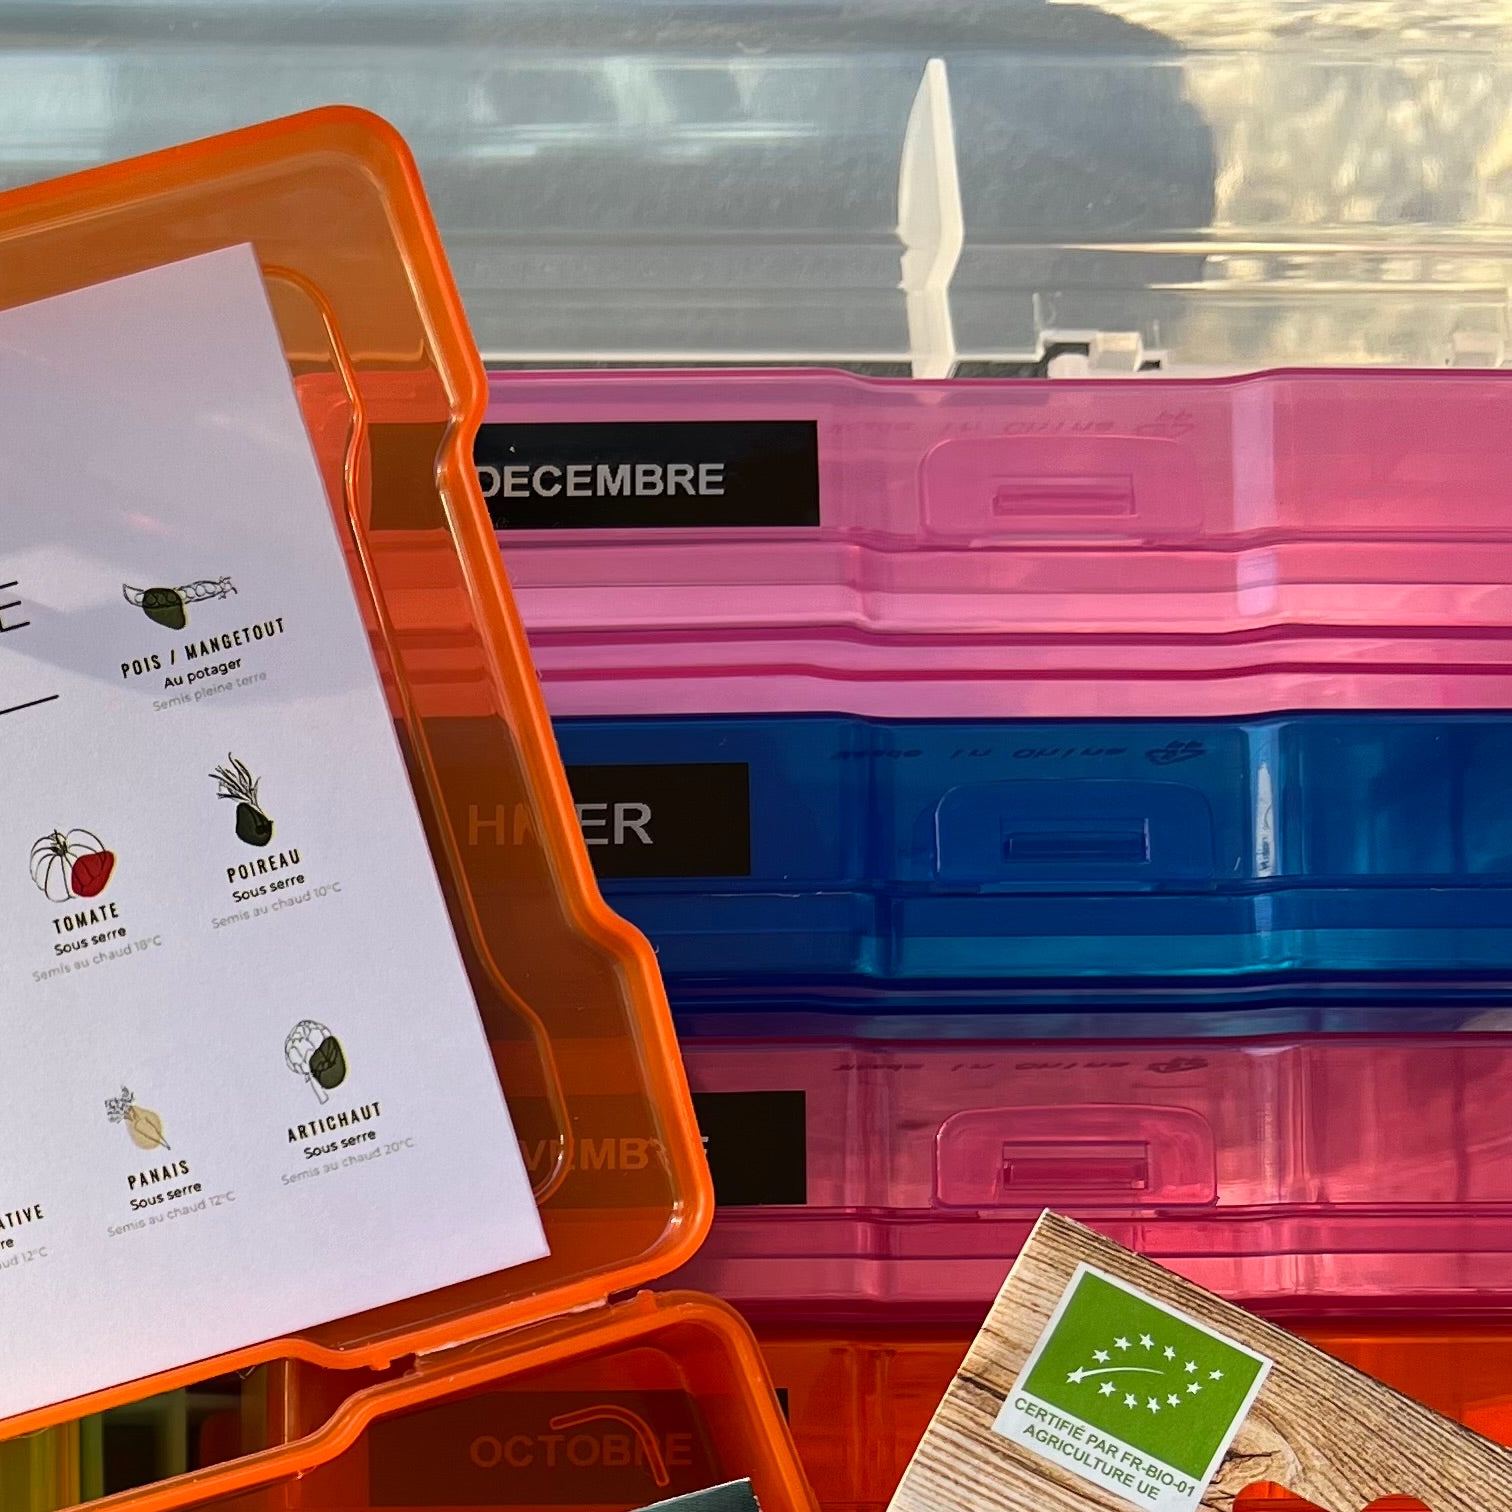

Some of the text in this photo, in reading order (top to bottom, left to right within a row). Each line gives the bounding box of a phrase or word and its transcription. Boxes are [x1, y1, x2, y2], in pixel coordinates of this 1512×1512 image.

[476, 463, 726, 498] DECEMBRE
[119, 616, 284, 679] POIS / MANGETOUT
[151, 671, 267, 712] Semis pleine terre
[163, 657, 241, 689] Au potager
[225, 847, 300, 884] POIREAU
[231, 873, 305, 903] Sous serre
[51, 901, 119, 935] TOMATE
[210, 909, 251, 930] Semis
[252, 905, 269, 917] au
[270, 889, 312, 912] chaud
[53, 926, 127, 956] Sous serre
[31, 961, 71, 983] Semis
[72, 958, 90, 970] au
[91, 942, 133, 965] chaud
[286, 1100, 380, 1143] ARTICHAUT
[302, 1129, 376, 1160] Sous serre
[126, 1158, 190, 1191] PANAIS
[280, 1166, 321, 1186] Semis
[322, 1160, 339, 1174] au
[340, 1145, 382, 1168] chaud
[128, 1181, 202, 1211] Sous serre
[1014, 1397, 1195, 1497] CERTIFIÉ PAR FR-BIO-01
[1022, 1423, 1160, 1500] AGRICULTURE UE
